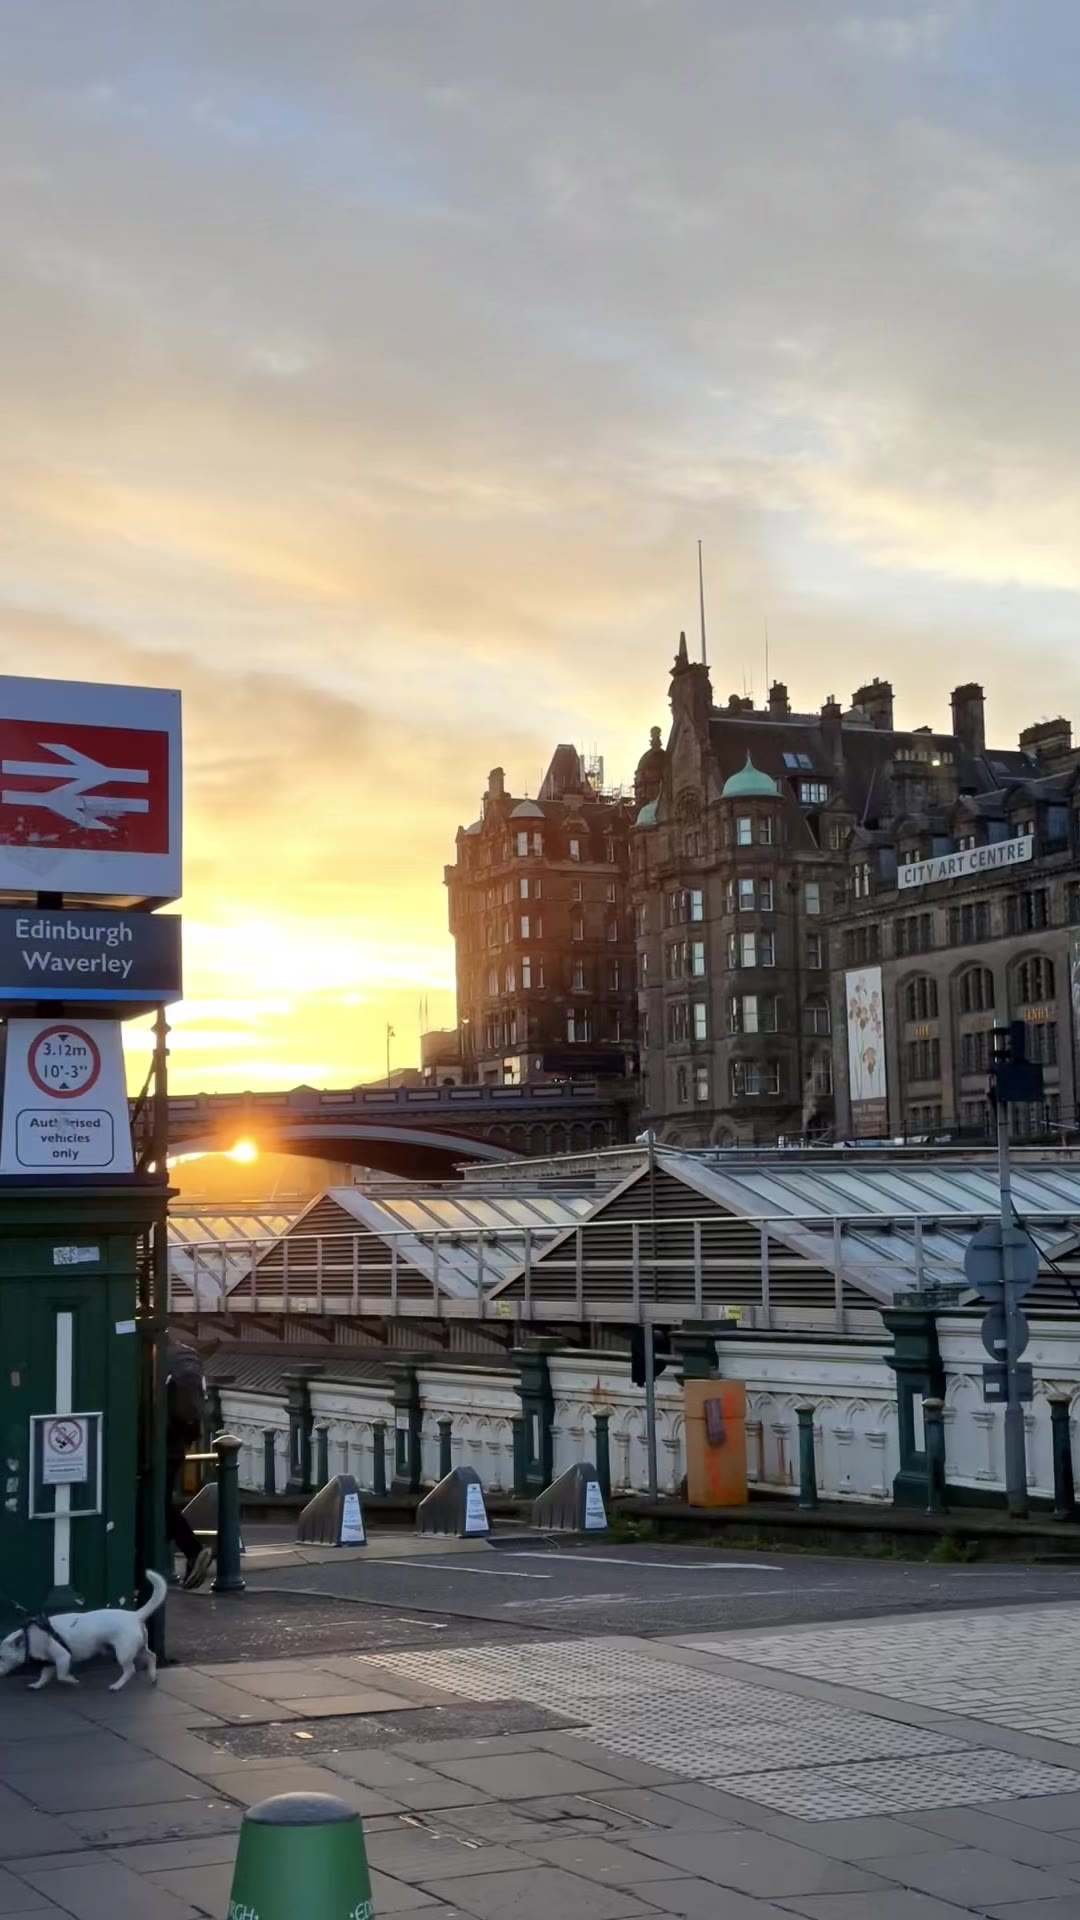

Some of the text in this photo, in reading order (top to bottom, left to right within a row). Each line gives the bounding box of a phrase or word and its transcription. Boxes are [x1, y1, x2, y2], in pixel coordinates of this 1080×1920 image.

[904, 842, 1025, 884] CITY ART CENTRE
[15, 918, 133, 947] Edinburgh
[22, 950, 134, 978] Waverley
[43, 1042, 87, 1056] 3.12m
[41, 1132, 91, 1143] vehicles
[52, 1148, 79, 1161] only
